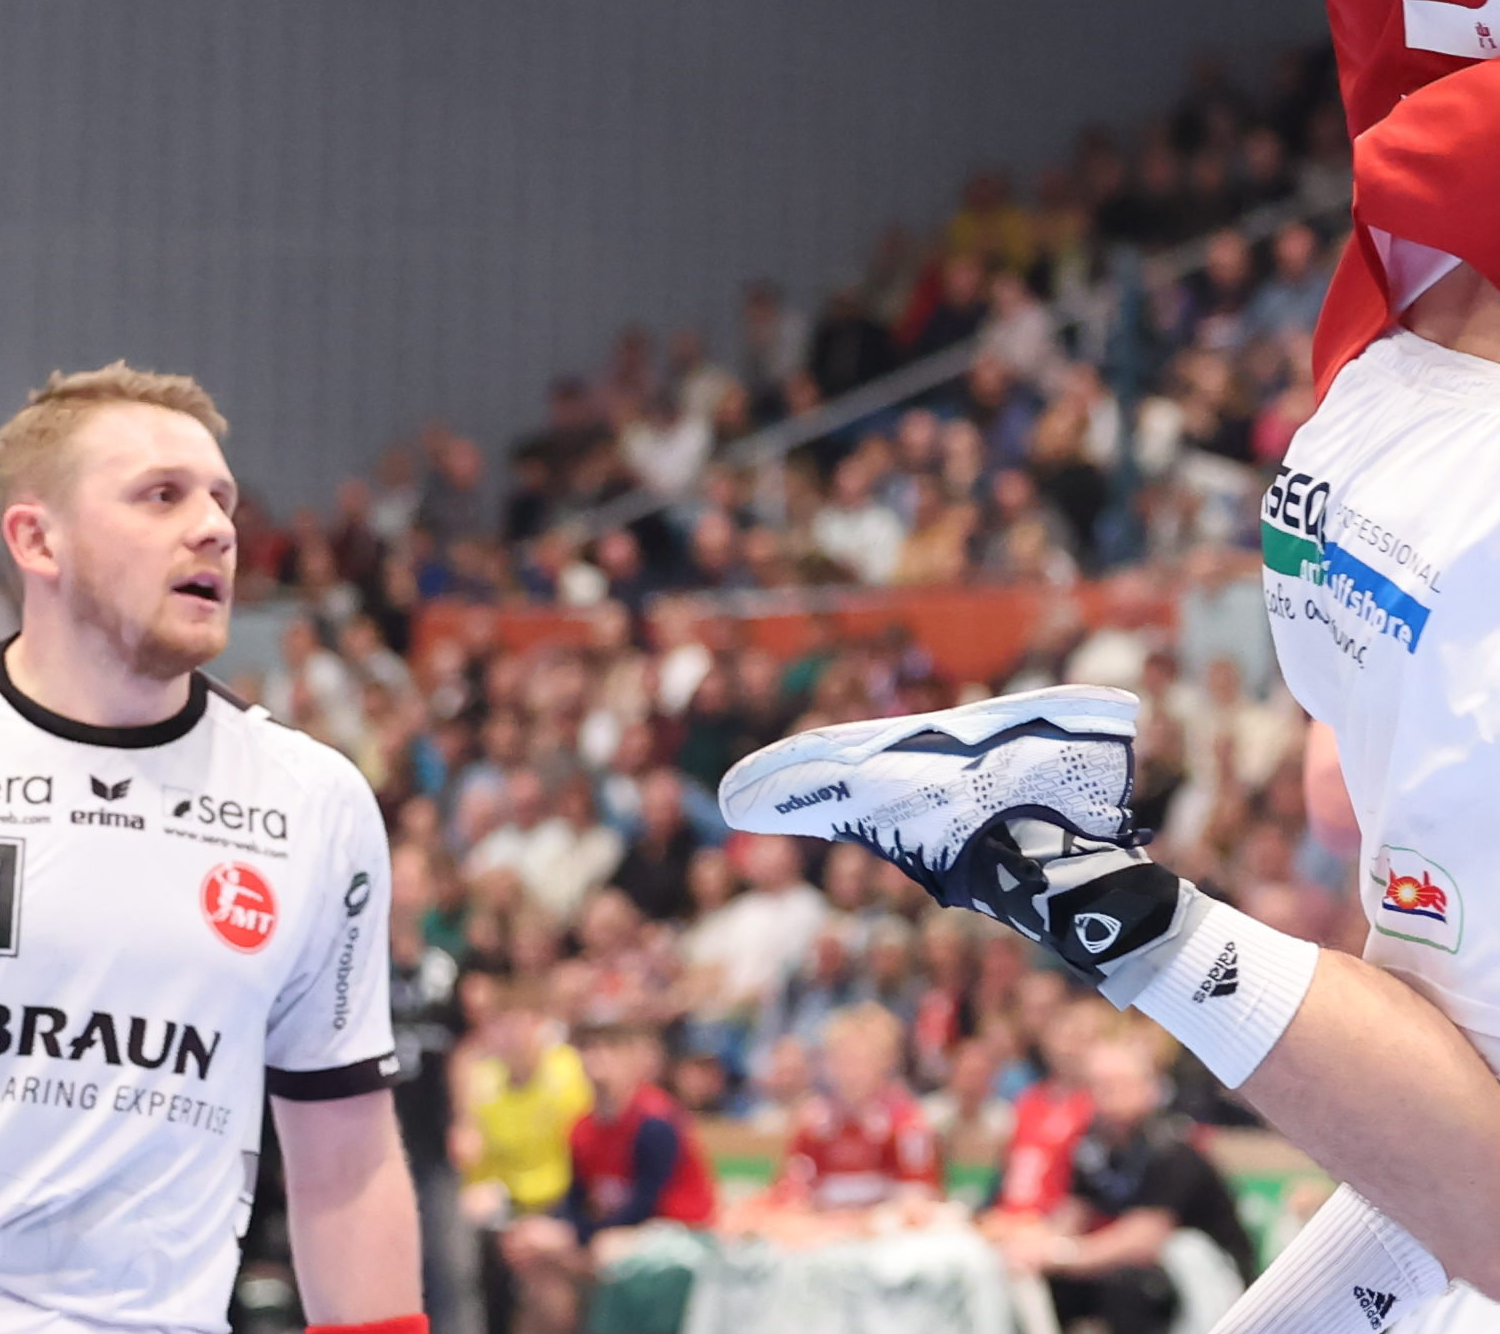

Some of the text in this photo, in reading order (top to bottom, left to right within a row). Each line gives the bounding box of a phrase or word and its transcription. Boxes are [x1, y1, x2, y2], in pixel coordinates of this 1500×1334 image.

[774, 780, 852, 815] Kempa
[70, 807, 146, 831] erima
[198, 793, 288, 841] sera
[231, 906, 275, 934] MT
[112, 1084, 232, 1135] EXPERTISE
